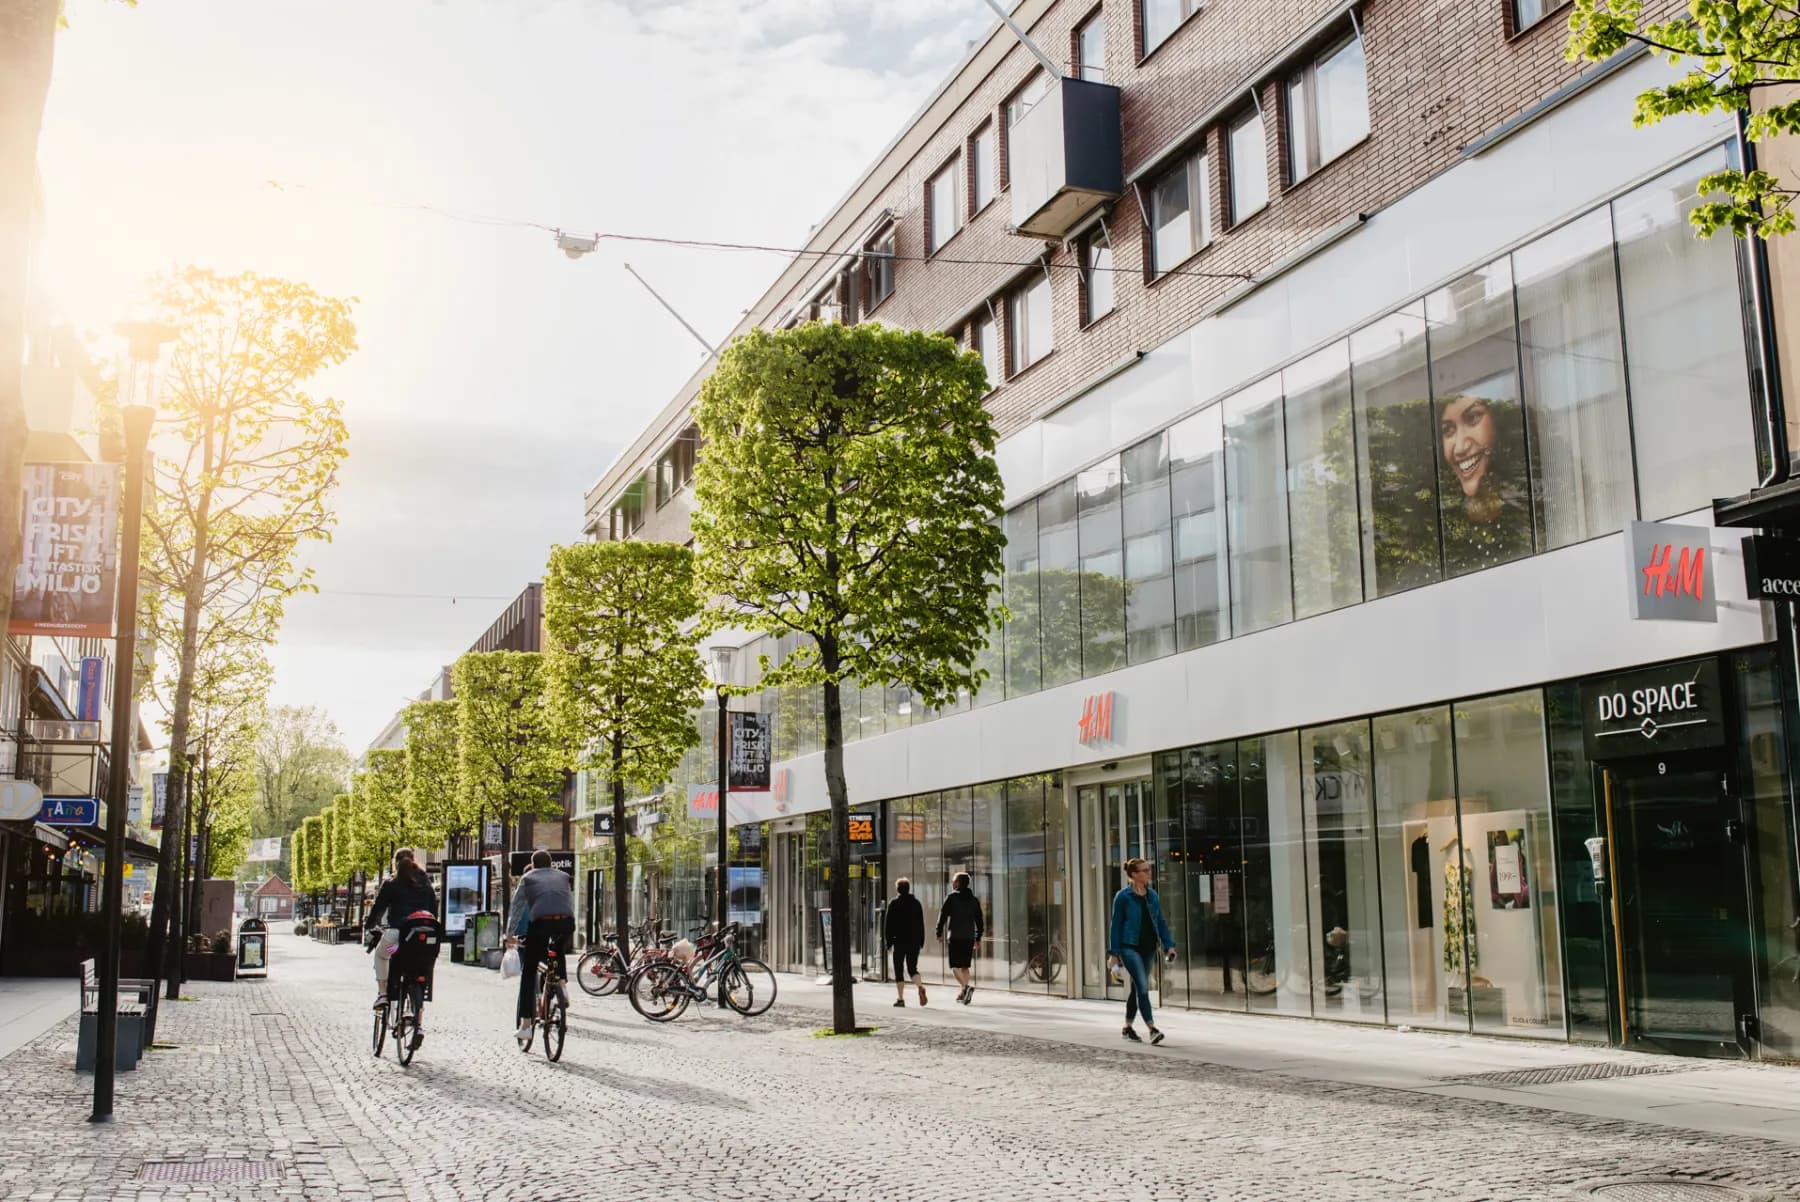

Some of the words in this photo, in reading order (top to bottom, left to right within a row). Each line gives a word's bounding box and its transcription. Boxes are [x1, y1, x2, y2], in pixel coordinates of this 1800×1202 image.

[1643, 543, 1705, 601] H&M
[1762, 577, 1800, 595] acce
[1599, 692, 1627, 721] DO
[1633, 681, 1698, 716] SPACE
[1078, 691, 1113, 745] H&M
[1658, 762, 1666, 775] 9
[848, 821, 872, 833] 24
